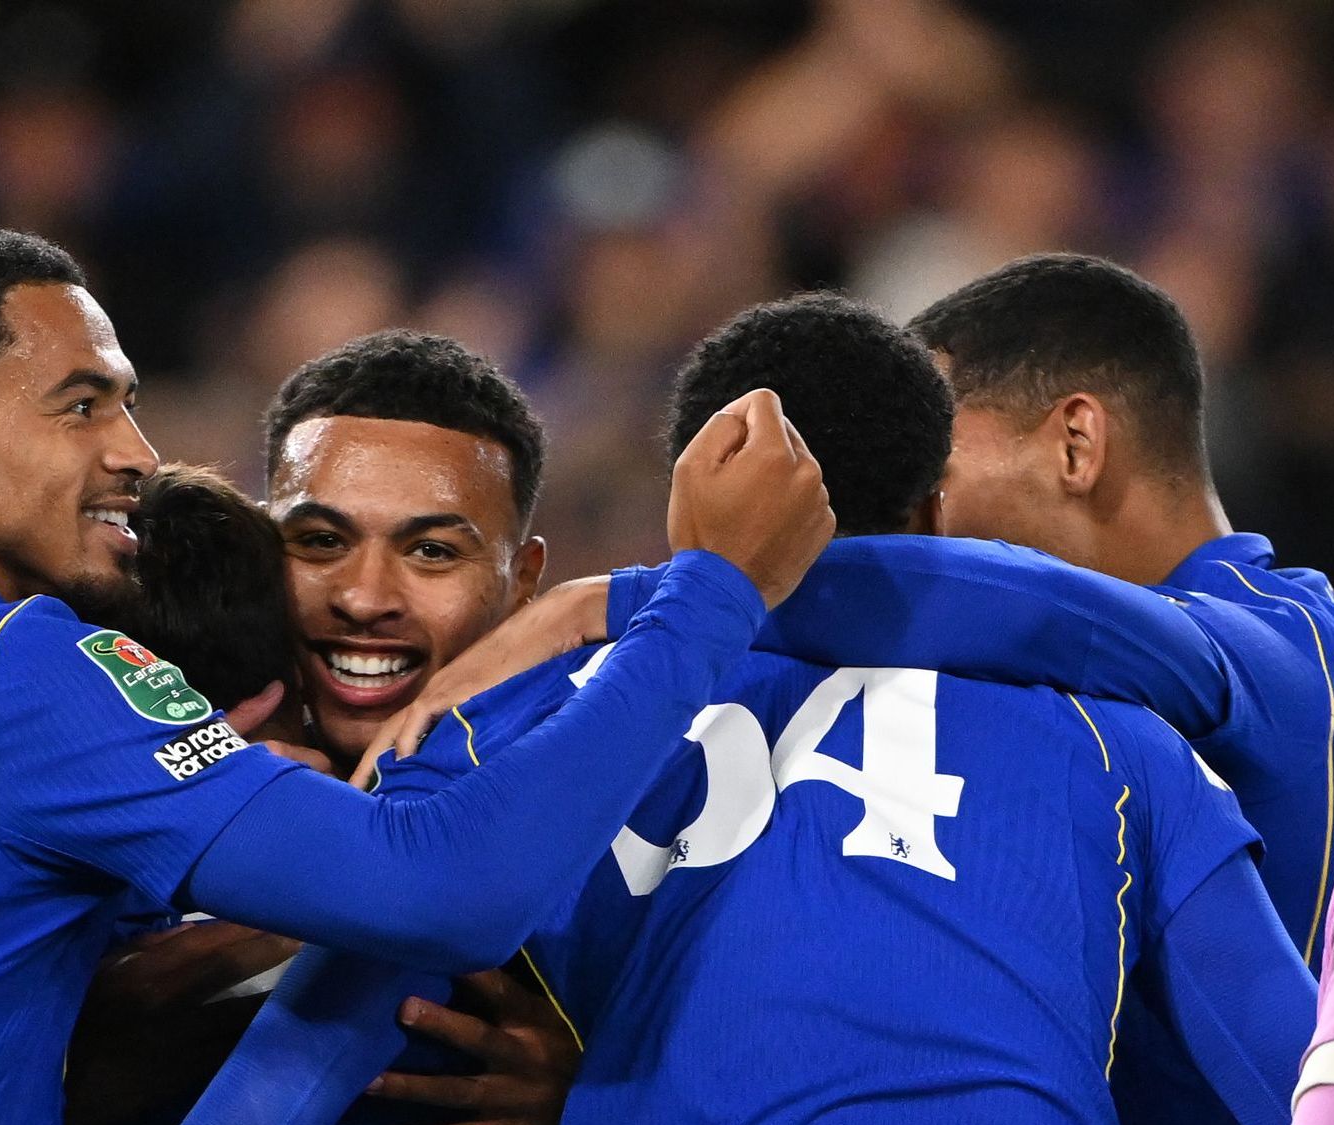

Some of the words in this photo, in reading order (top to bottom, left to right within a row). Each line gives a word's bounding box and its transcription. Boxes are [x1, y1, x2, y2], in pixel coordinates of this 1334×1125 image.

[147, 673, 174, 689] Cup
[182, 700, 204, 713] EFL
[153, 741, 192, 772] No
[168, 754, 205, 782] for
